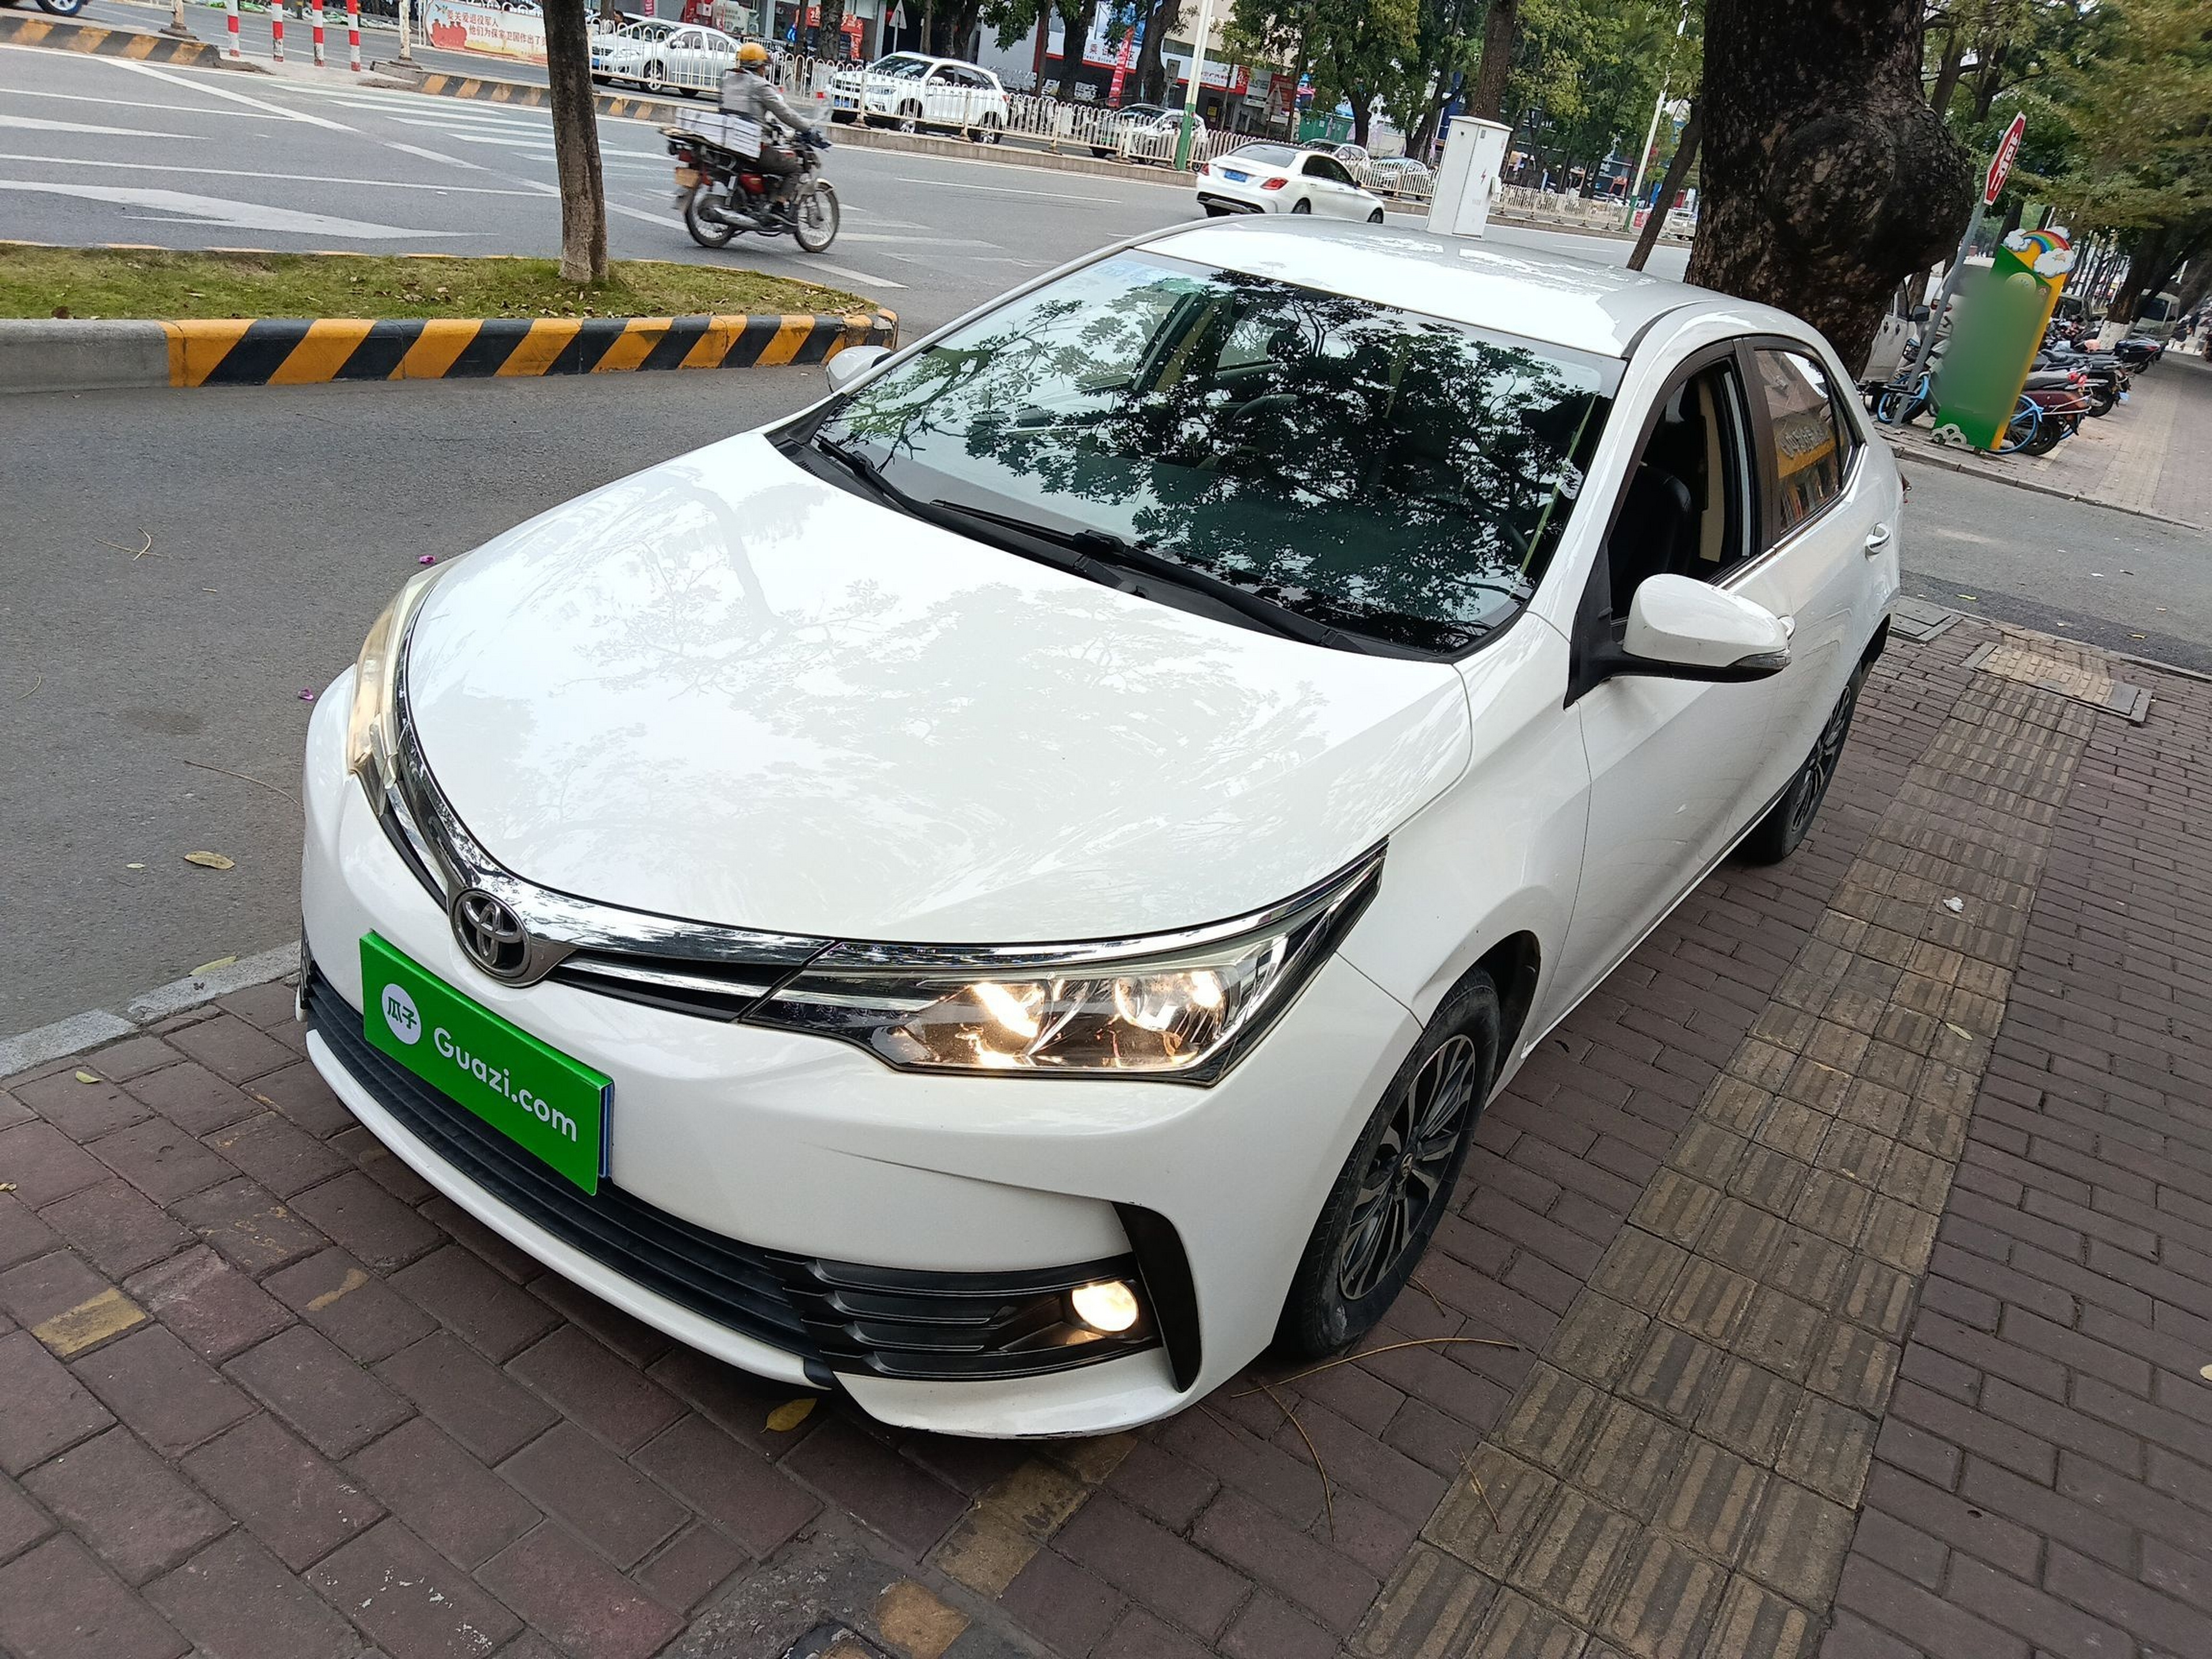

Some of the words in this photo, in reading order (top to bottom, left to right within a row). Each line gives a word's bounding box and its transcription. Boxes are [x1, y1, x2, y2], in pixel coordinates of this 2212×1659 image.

[1990, 131, 2019, 191] 停
[387, 996, 417, 1029] 瓜子
[434, 1027, 577, 1142] Guazi.com
